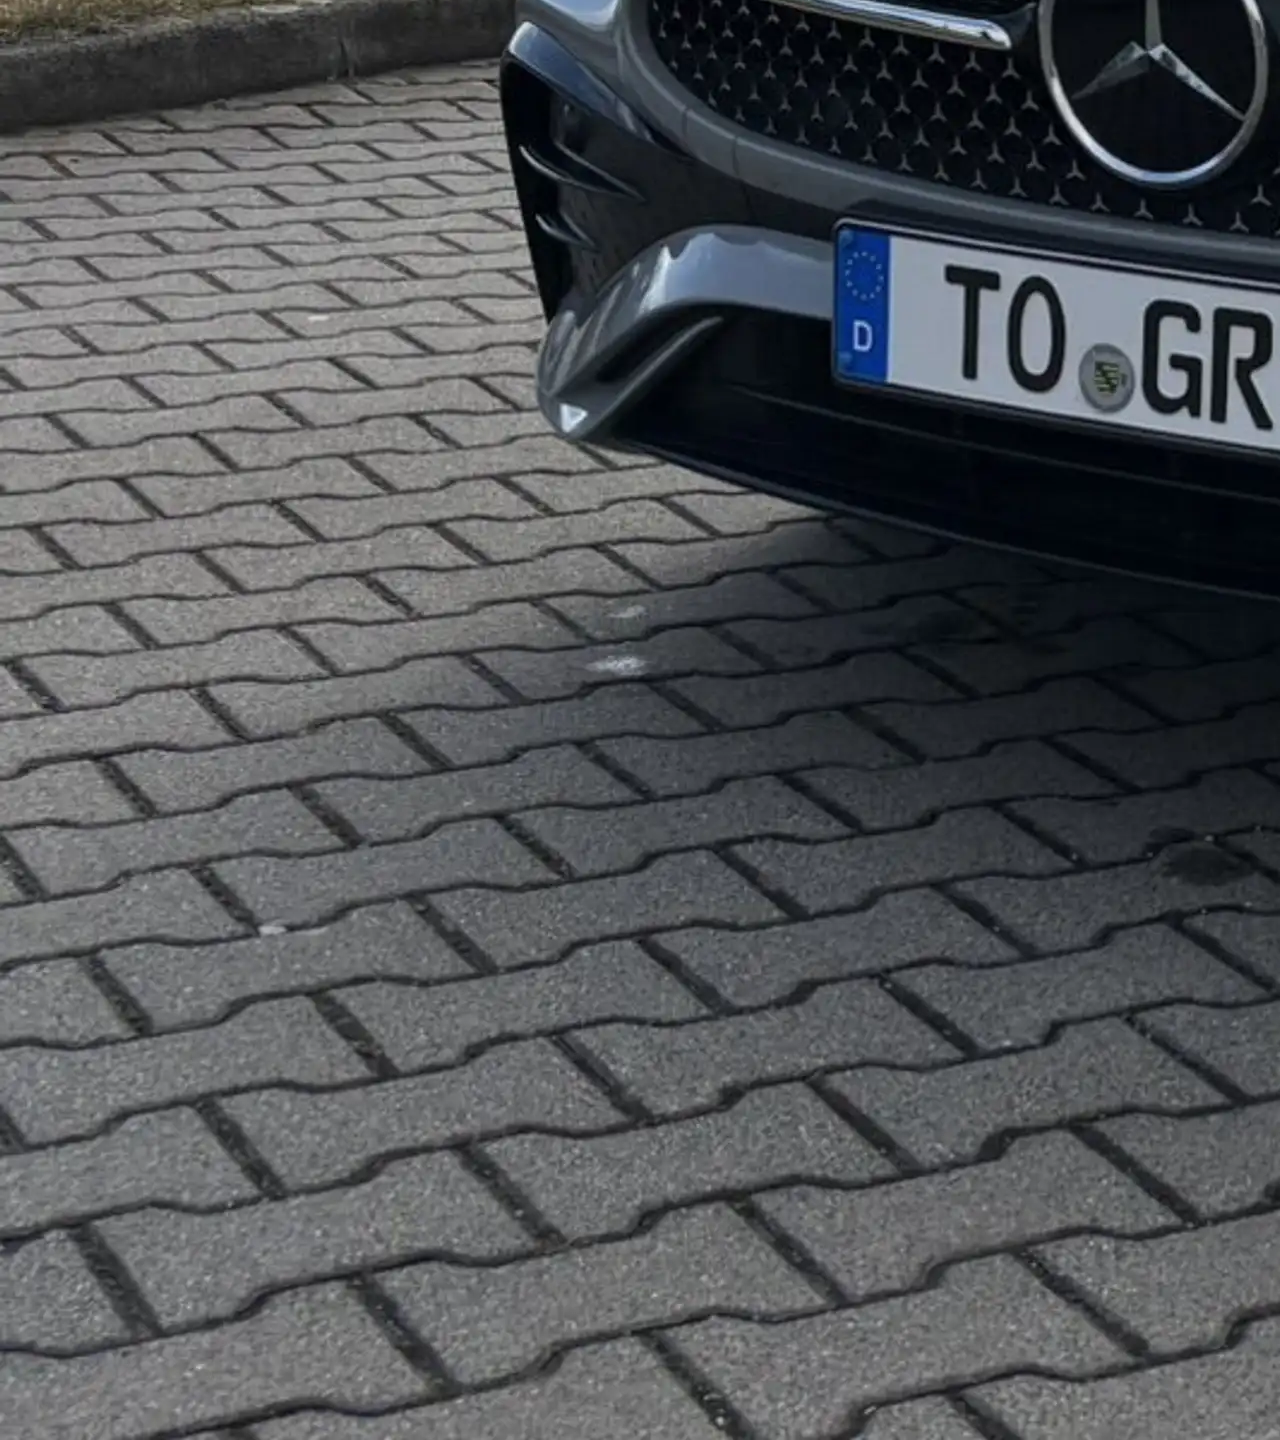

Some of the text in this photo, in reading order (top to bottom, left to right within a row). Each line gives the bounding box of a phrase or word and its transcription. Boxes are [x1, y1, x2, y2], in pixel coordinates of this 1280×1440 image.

[852, 319, 873, 352] D
[945, 264, 1066, 393] TO
[1142, 299, 1273, 431] GR
